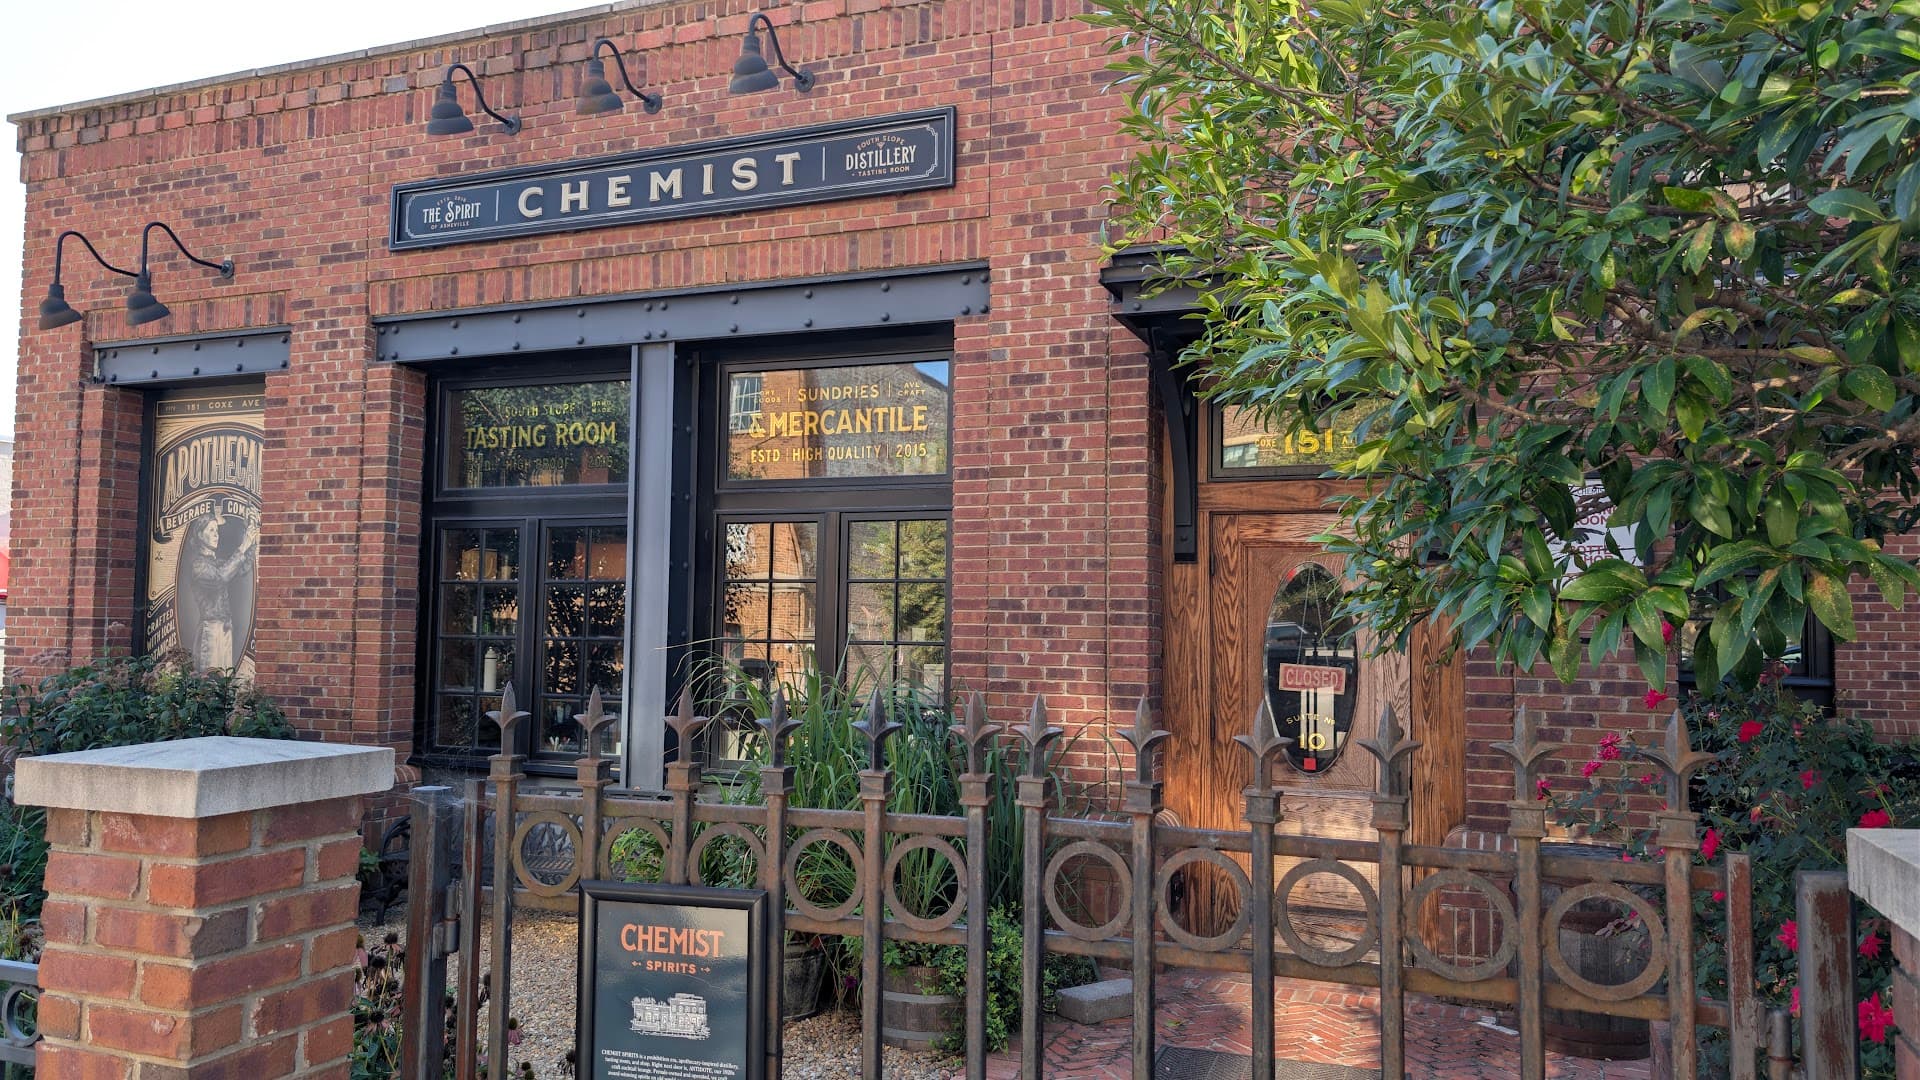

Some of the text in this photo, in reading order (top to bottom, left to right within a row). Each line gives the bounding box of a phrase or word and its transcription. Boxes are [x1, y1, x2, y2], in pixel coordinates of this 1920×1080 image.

[856, 135, 905, 151] SOUTH SLOPE
[845, 145, 917, 171] DISTILLERY
[858, 165, 910, 177] TASTING ROOM
[518, 152, 800, 218] CHEMIST
[422, 207, 441, 224] THE
[440, 221, 470, 229] ASHEVILLE
[798, 384, 880, 402] SUNDRIES
[898, 389, 926, 397] CRAFT
[208, 401, 233, 409] COXE
[241, 399, 260, 407] AVE
[505, 405, 539, 418] SOUTH
[749, 405, 929, 438] & MERCANTILE
[464, 420, 617, 450] TASTING ROOM
[1254, 438, 1277, 447] COXE
[1284, 428, 1334, 454] 151
[751, 443, 928, 463] ESTD HIGH QUALITY 2015
[166, 501, 211, 530] BEVERAGE
[147, 608, 174, 635] CRAFTED
[1285, 669, 1339, 688] CLOSED
[1286, 712, 1320, 725] SUITE
[1298, 732, 1326, 750] 10
[621, 923, 725, 957] CHEMIST
[646, 960, 697, 974] SPIRITS
